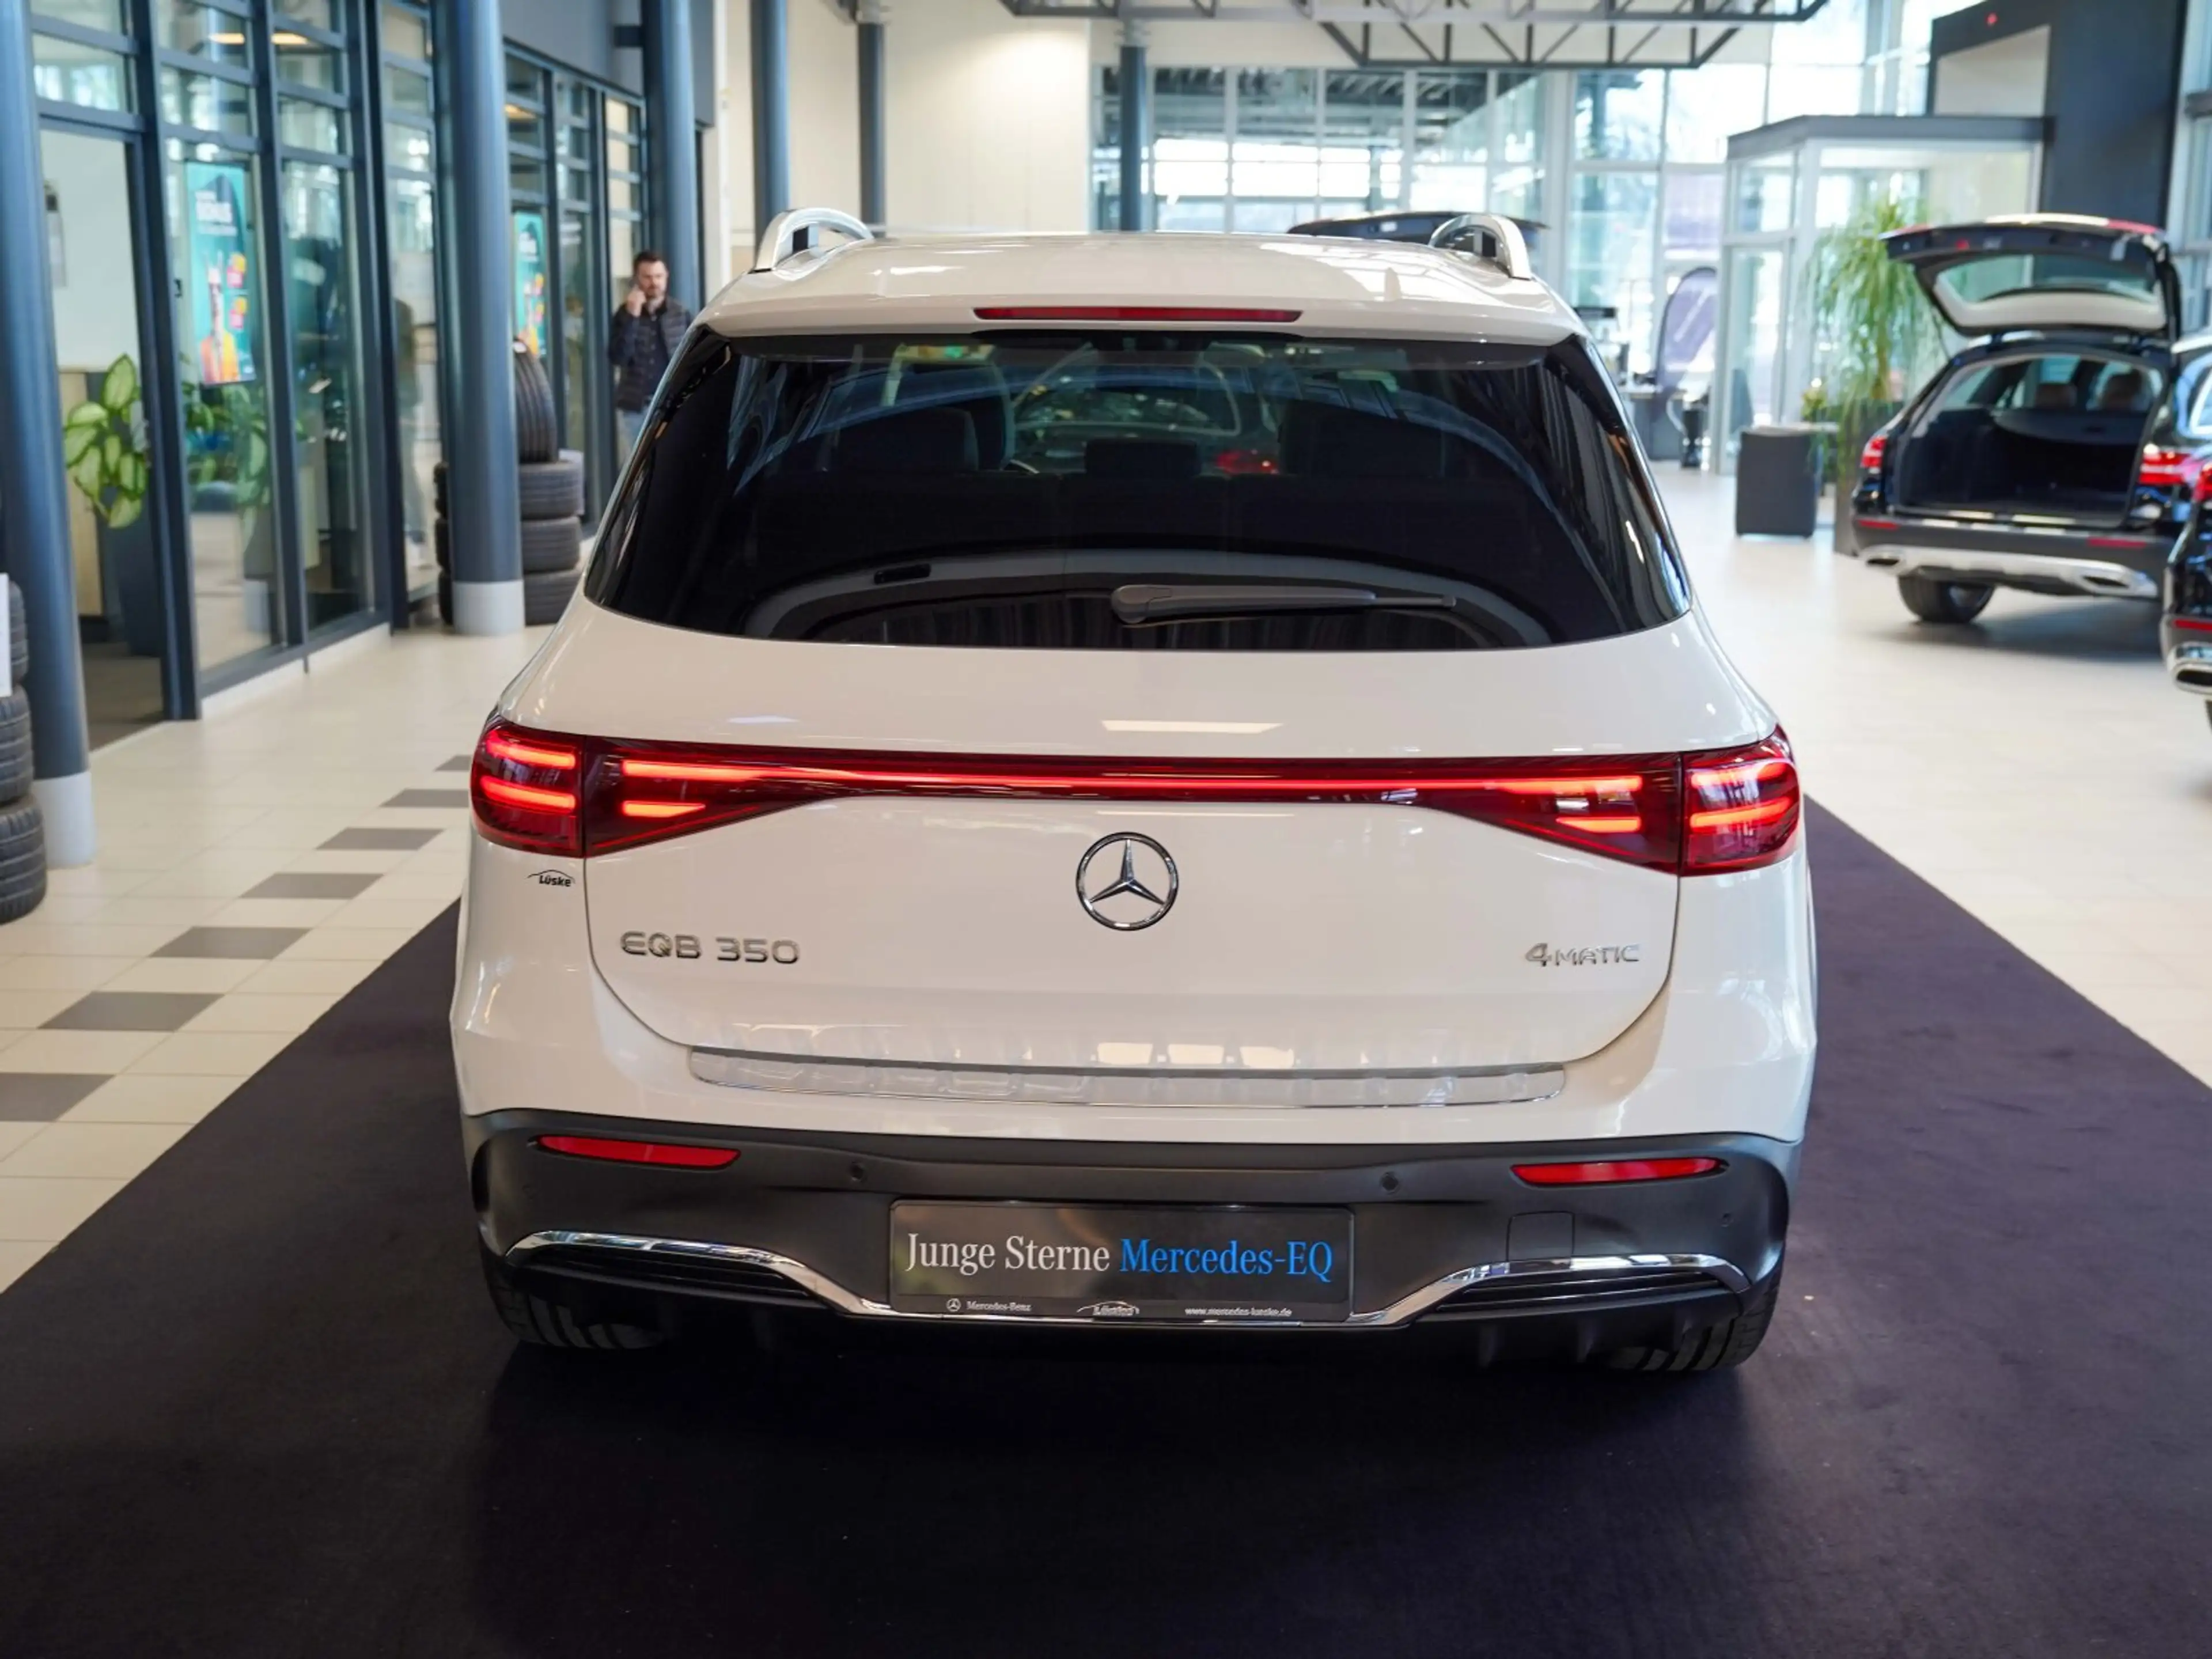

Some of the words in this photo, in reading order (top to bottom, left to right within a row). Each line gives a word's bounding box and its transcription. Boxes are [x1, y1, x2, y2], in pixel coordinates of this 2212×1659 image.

[620, 931, 702, 959] EQB
[715, 937, 800, 964] 350
[1525, 942, 1641, 967] 4MATIC
[905, 1233, 995, 1275] Junge
[1005, 1235, 1110, 1271] Sterne
[1120, 1238, 1332, 1283] Mercedes-EQ
[965, 1300, 1032, 1312] Mercedes-Benz
